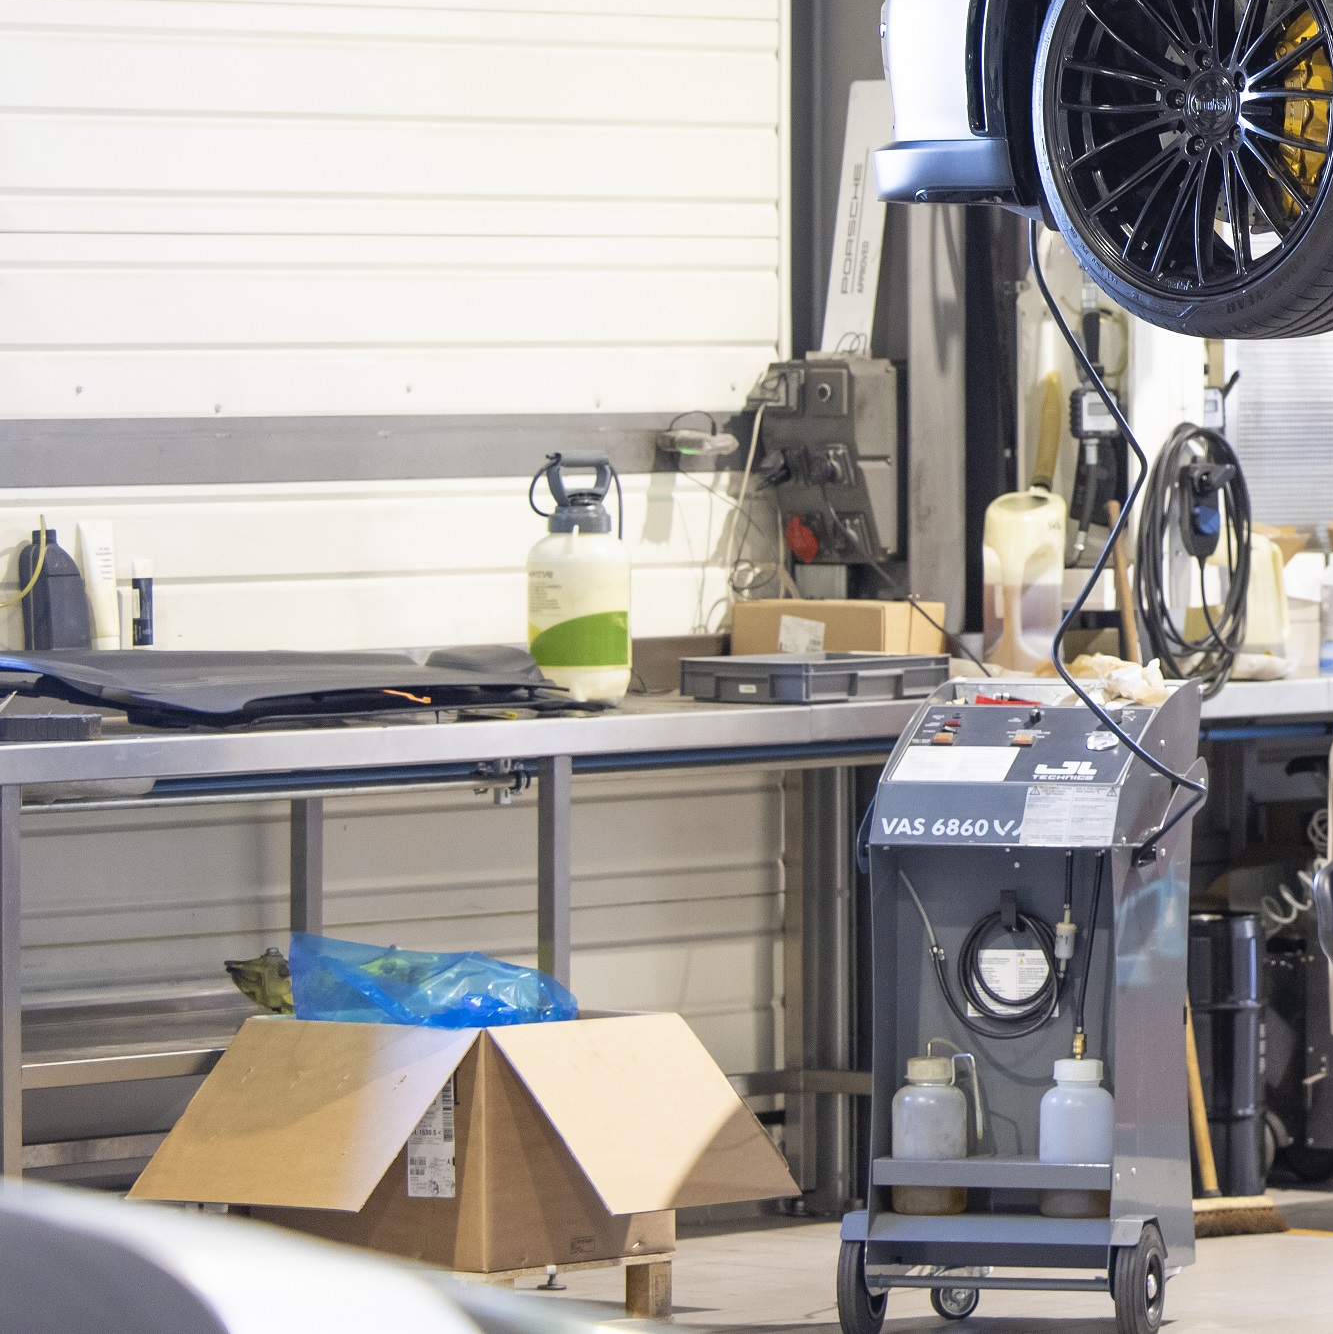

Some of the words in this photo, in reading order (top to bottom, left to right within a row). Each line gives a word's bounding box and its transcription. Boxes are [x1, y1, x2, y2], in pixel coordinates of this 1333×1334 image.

[840, 163, 863, 295] PORSCHE
[857, 239, 870, 295] APPROVED
[881, 817, 925, 836] VAS
[931, 818, 989, 837] 6860
[993, 819, 1023, 837] V
